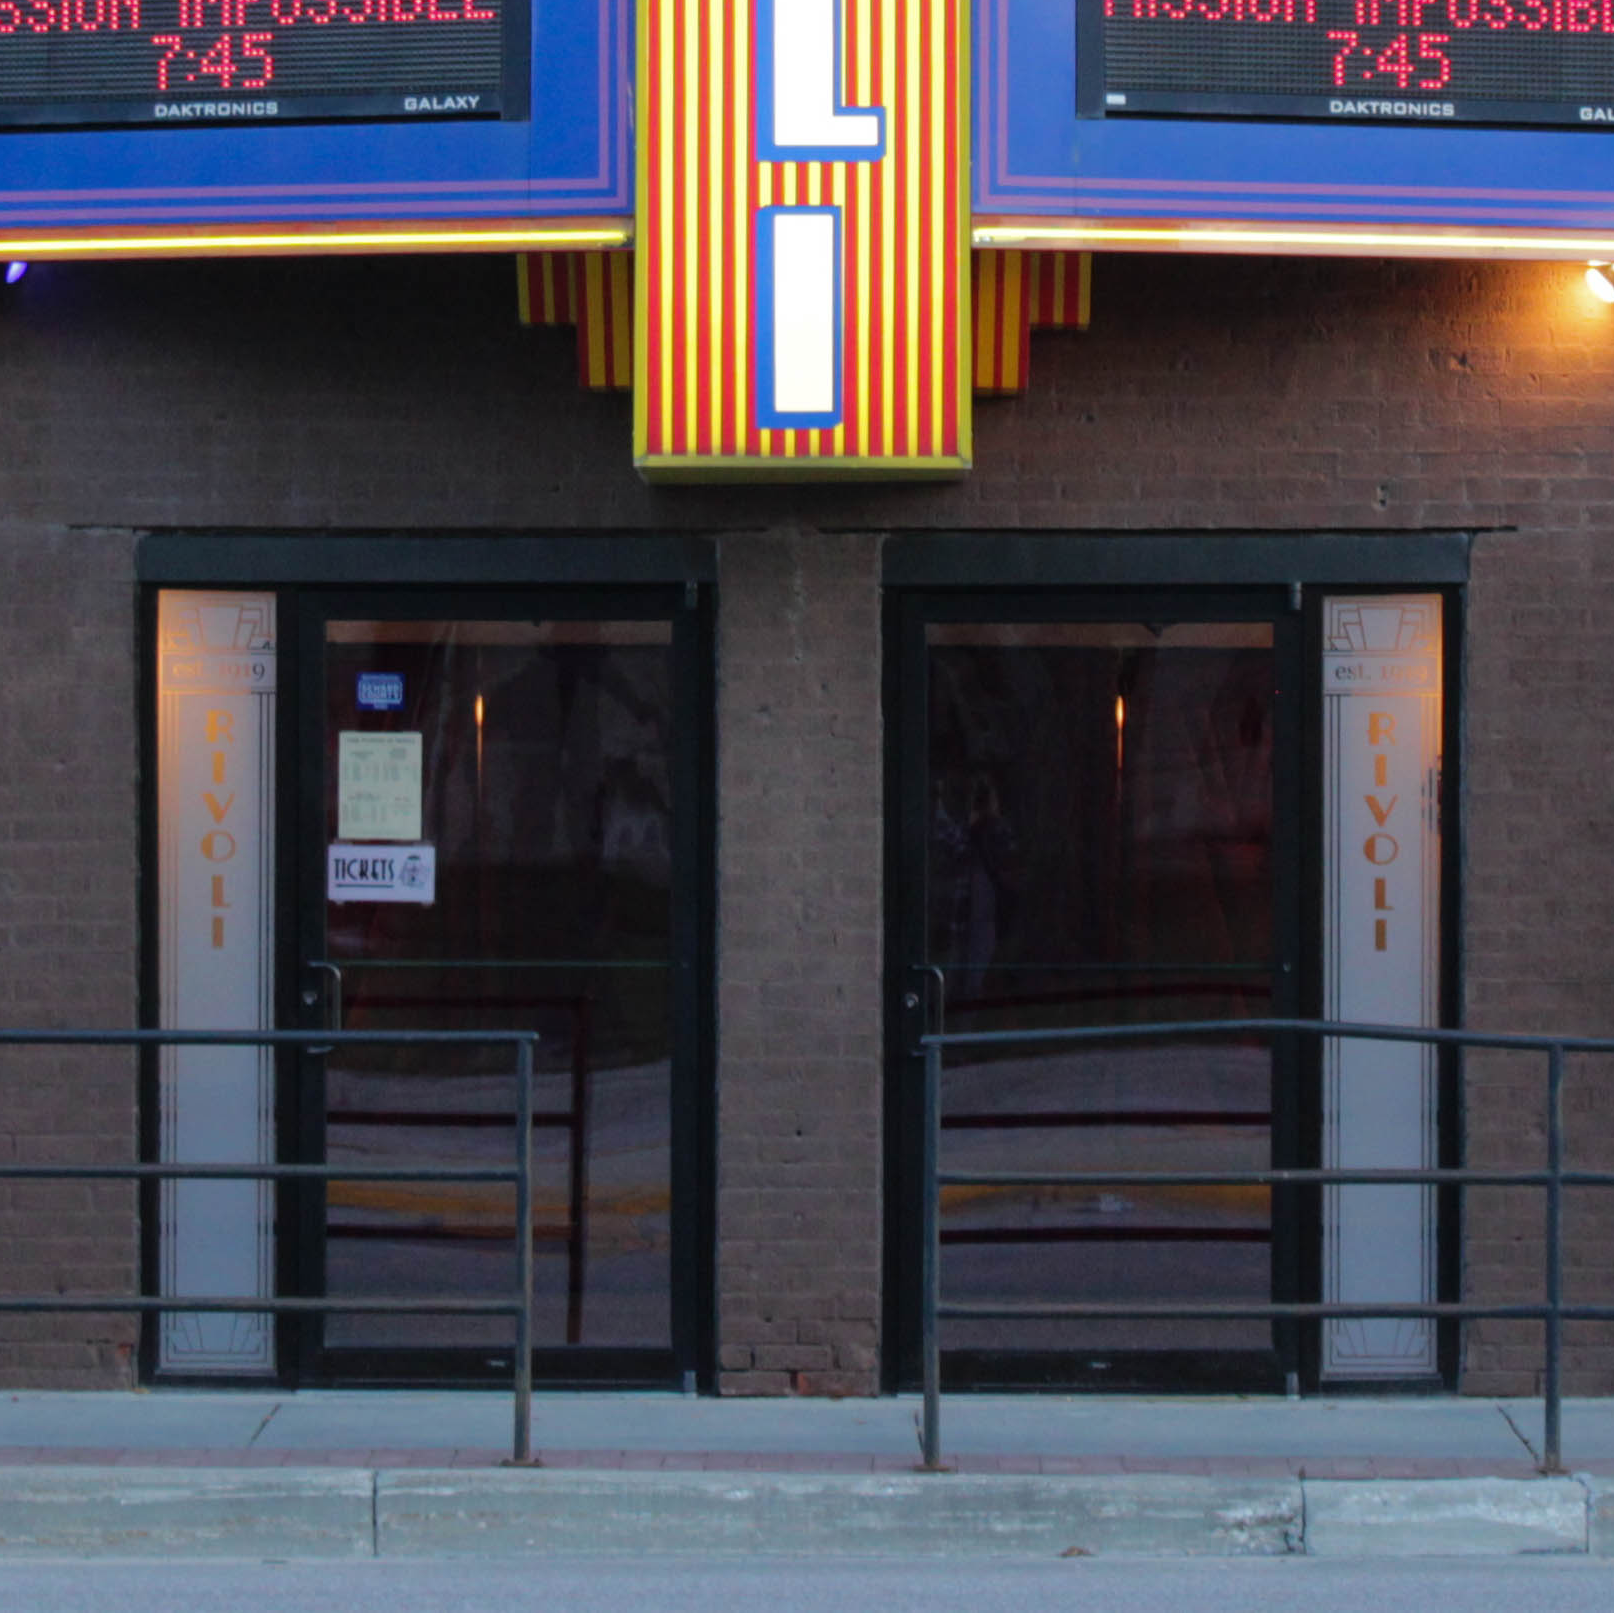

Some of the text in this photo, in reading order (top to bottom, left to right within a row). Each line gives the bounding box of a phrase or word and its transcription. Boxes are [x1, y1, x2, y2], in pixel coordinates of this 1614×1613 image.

[151, 32, 274, 90] 7:45
[1327, 30, 1452, 89] 7:45
[154, 101, 278, 117] DAKTRONICS
[404, 95, 481, 111] GALAXY
[1329, 100, 1455, 117] DAKTRONICS
[199, 709, 237, 950] RIVOLI
[1363, 711, 1399, 952] RIVOLI
[334, 858, 395, 880] TICKETS
